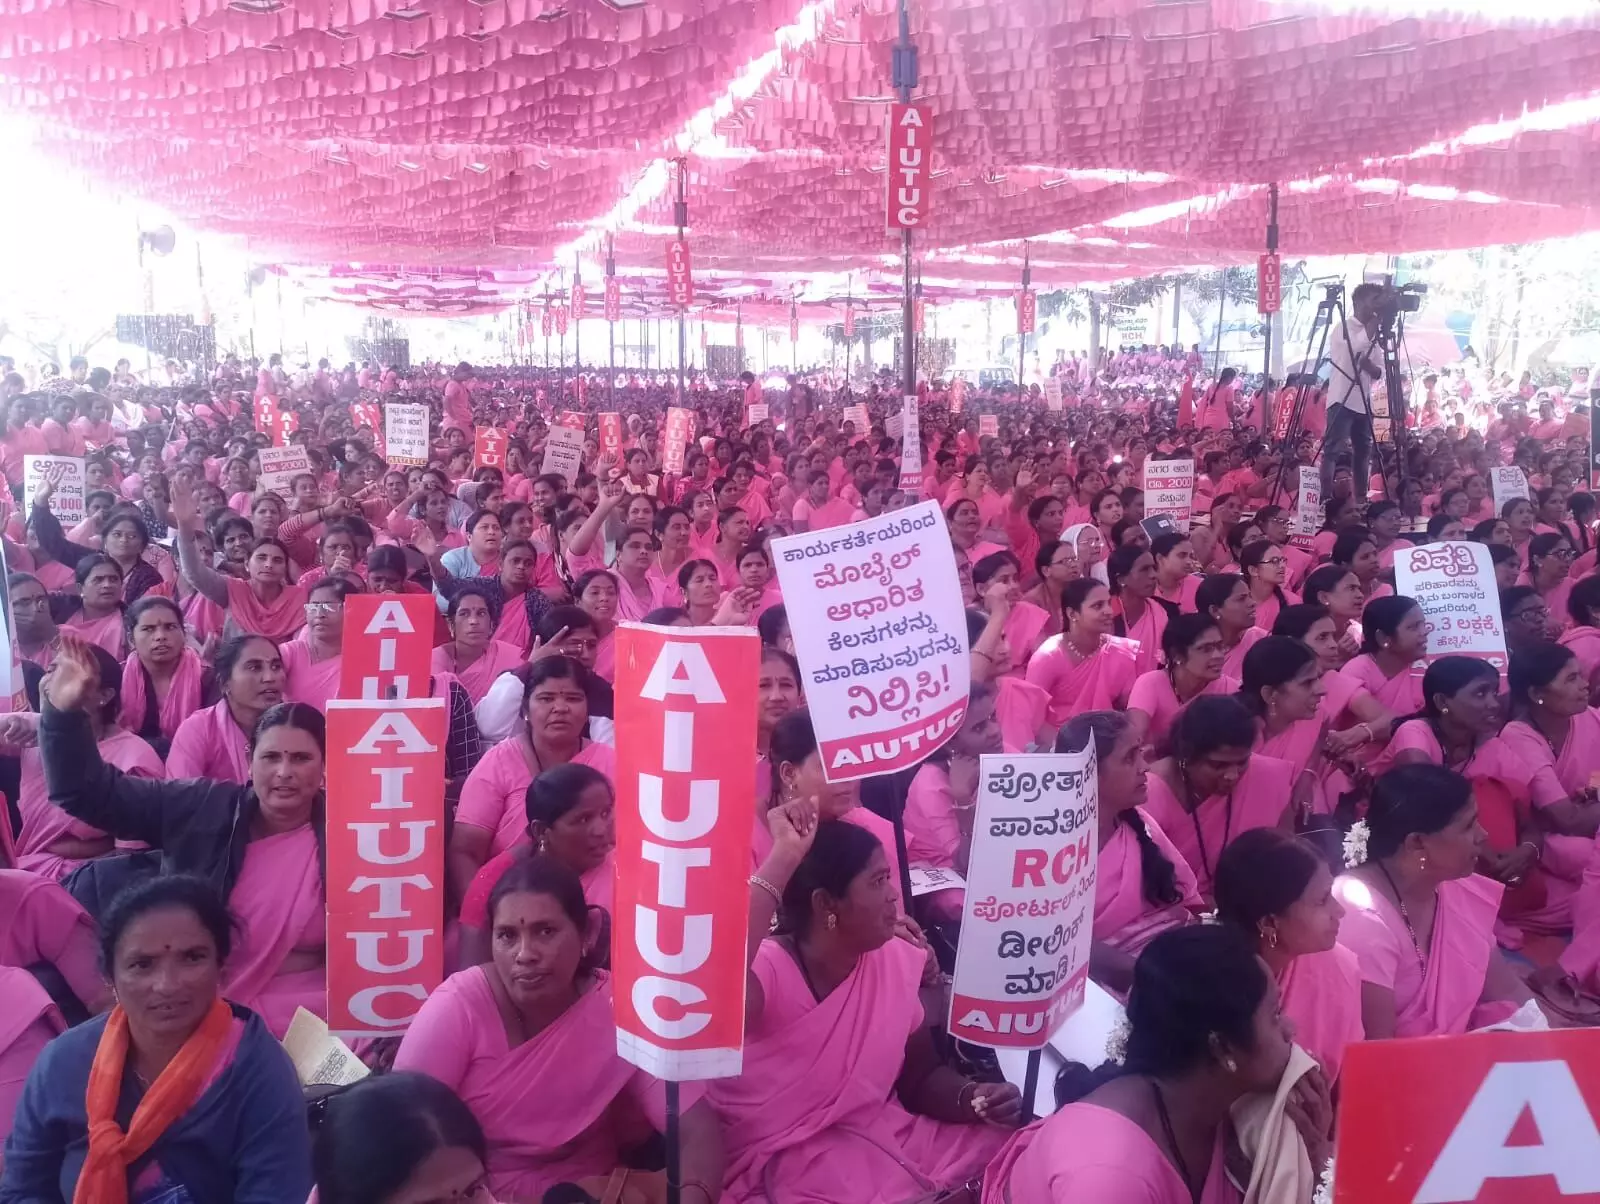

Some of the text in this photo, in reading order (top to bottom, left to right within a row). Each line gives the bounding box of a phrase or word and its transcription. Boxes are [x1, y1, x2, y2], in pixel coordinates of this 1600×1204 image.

[898, 108, 923, 226] AIUTUC
[670, 242, 687, 303] AIUTUC
[1265, 256, 1276, 311] AIUTUC
[1278, 393, 1293, 437] AIUTUC
[480, 427, 503, 465] AIU
[783, 511, 936, 562] ಕಾರ್ಯಕರ್ತೆಯರಿಂದ
[813, 543, 921, 589] ಮೊಬೈಲ್
[826, 578, 925, 621] ಆಧಾರಿತ
[364, 601, 416, 700] AIU
[812, 633, 963, 684] ಮಾಡಿಸುವುದನ್ನು
[827, 611, 939, 652] ಕೆಲಸಗಳನ್ನು
[847, 663, 950, 722] ನಿಲ್ಲಿಸಿ!
[831, 707, 965, 769] AIUTUC
[631, 642, 727, 1039] AIUTUC
[1012, 829, 1091, 888] RCH
[346, 712, 438, 1027] AIUTUC
[997, 905, 1086, 959] ಡೀಲಿಂಕ್
[1005, 946, 1077, 995] ಮಾಡಿ!
[957, 977, 1086, 1034] AIUTUC
